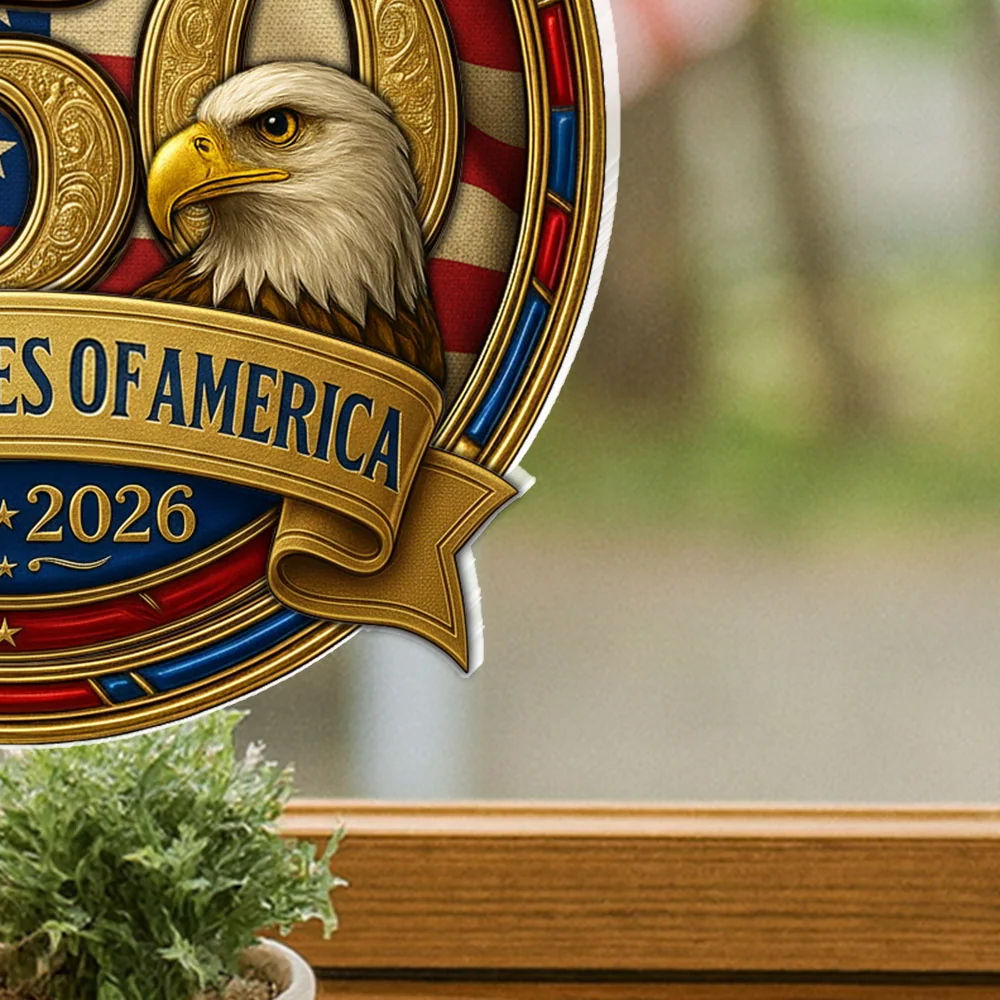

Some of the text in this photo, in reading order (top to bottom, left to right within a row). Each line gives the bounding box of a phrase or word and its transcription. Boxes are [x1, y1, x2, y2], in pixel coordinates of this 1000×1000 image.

[69, 338, 147, 418] OF
[146, 348, 403, 494] AMERICA
[25, 483, 197, 543] 2026
